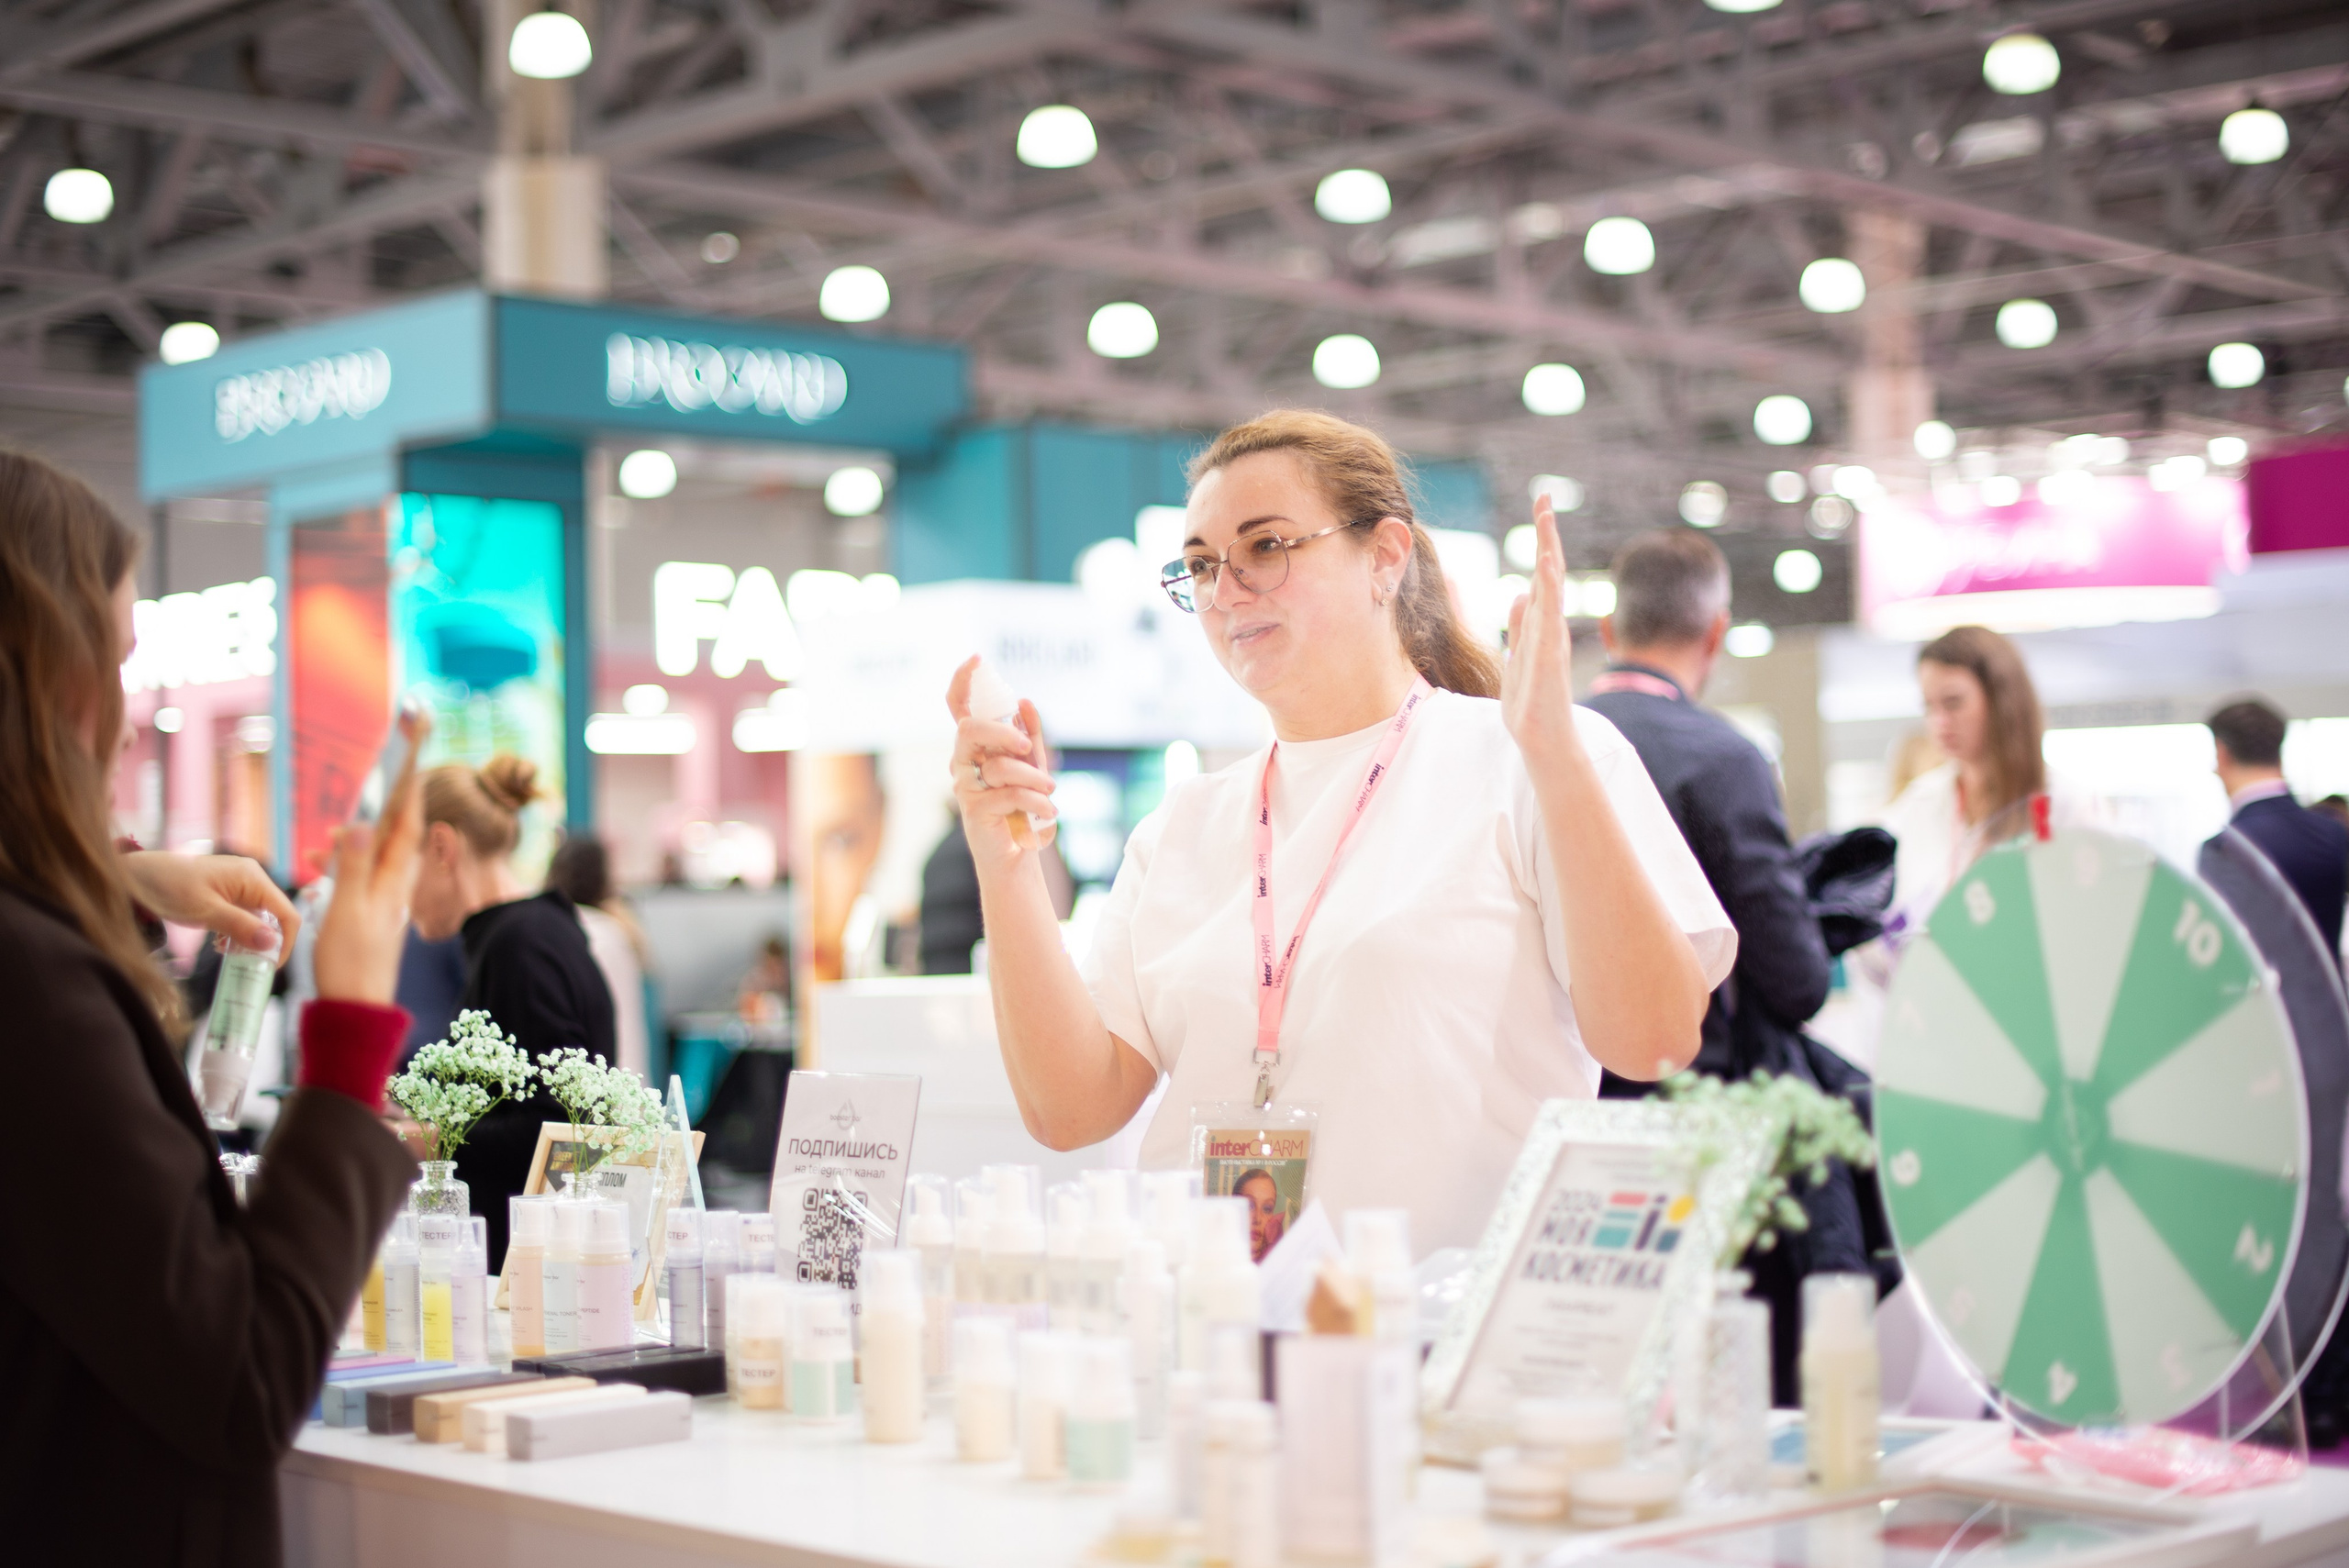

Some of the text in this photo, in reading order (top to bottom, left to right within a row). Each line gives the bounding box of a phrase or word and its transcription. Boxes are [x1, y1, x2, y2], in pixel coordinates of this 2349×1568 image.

[1257, 853, 1267, 898] interCHARM
[2172, 898, 2223, 969] 10
[1262, 934, 1273, 986] interCHARM
[788, 1138, 898, 1161] ПОДПИШИСЬ
[1209, 1135, 1304, 1157] interCHARM
[795, 1164, 885, 1179] на telegram канал
[741, 1368, 776, 1377] ТЕСТЕР
